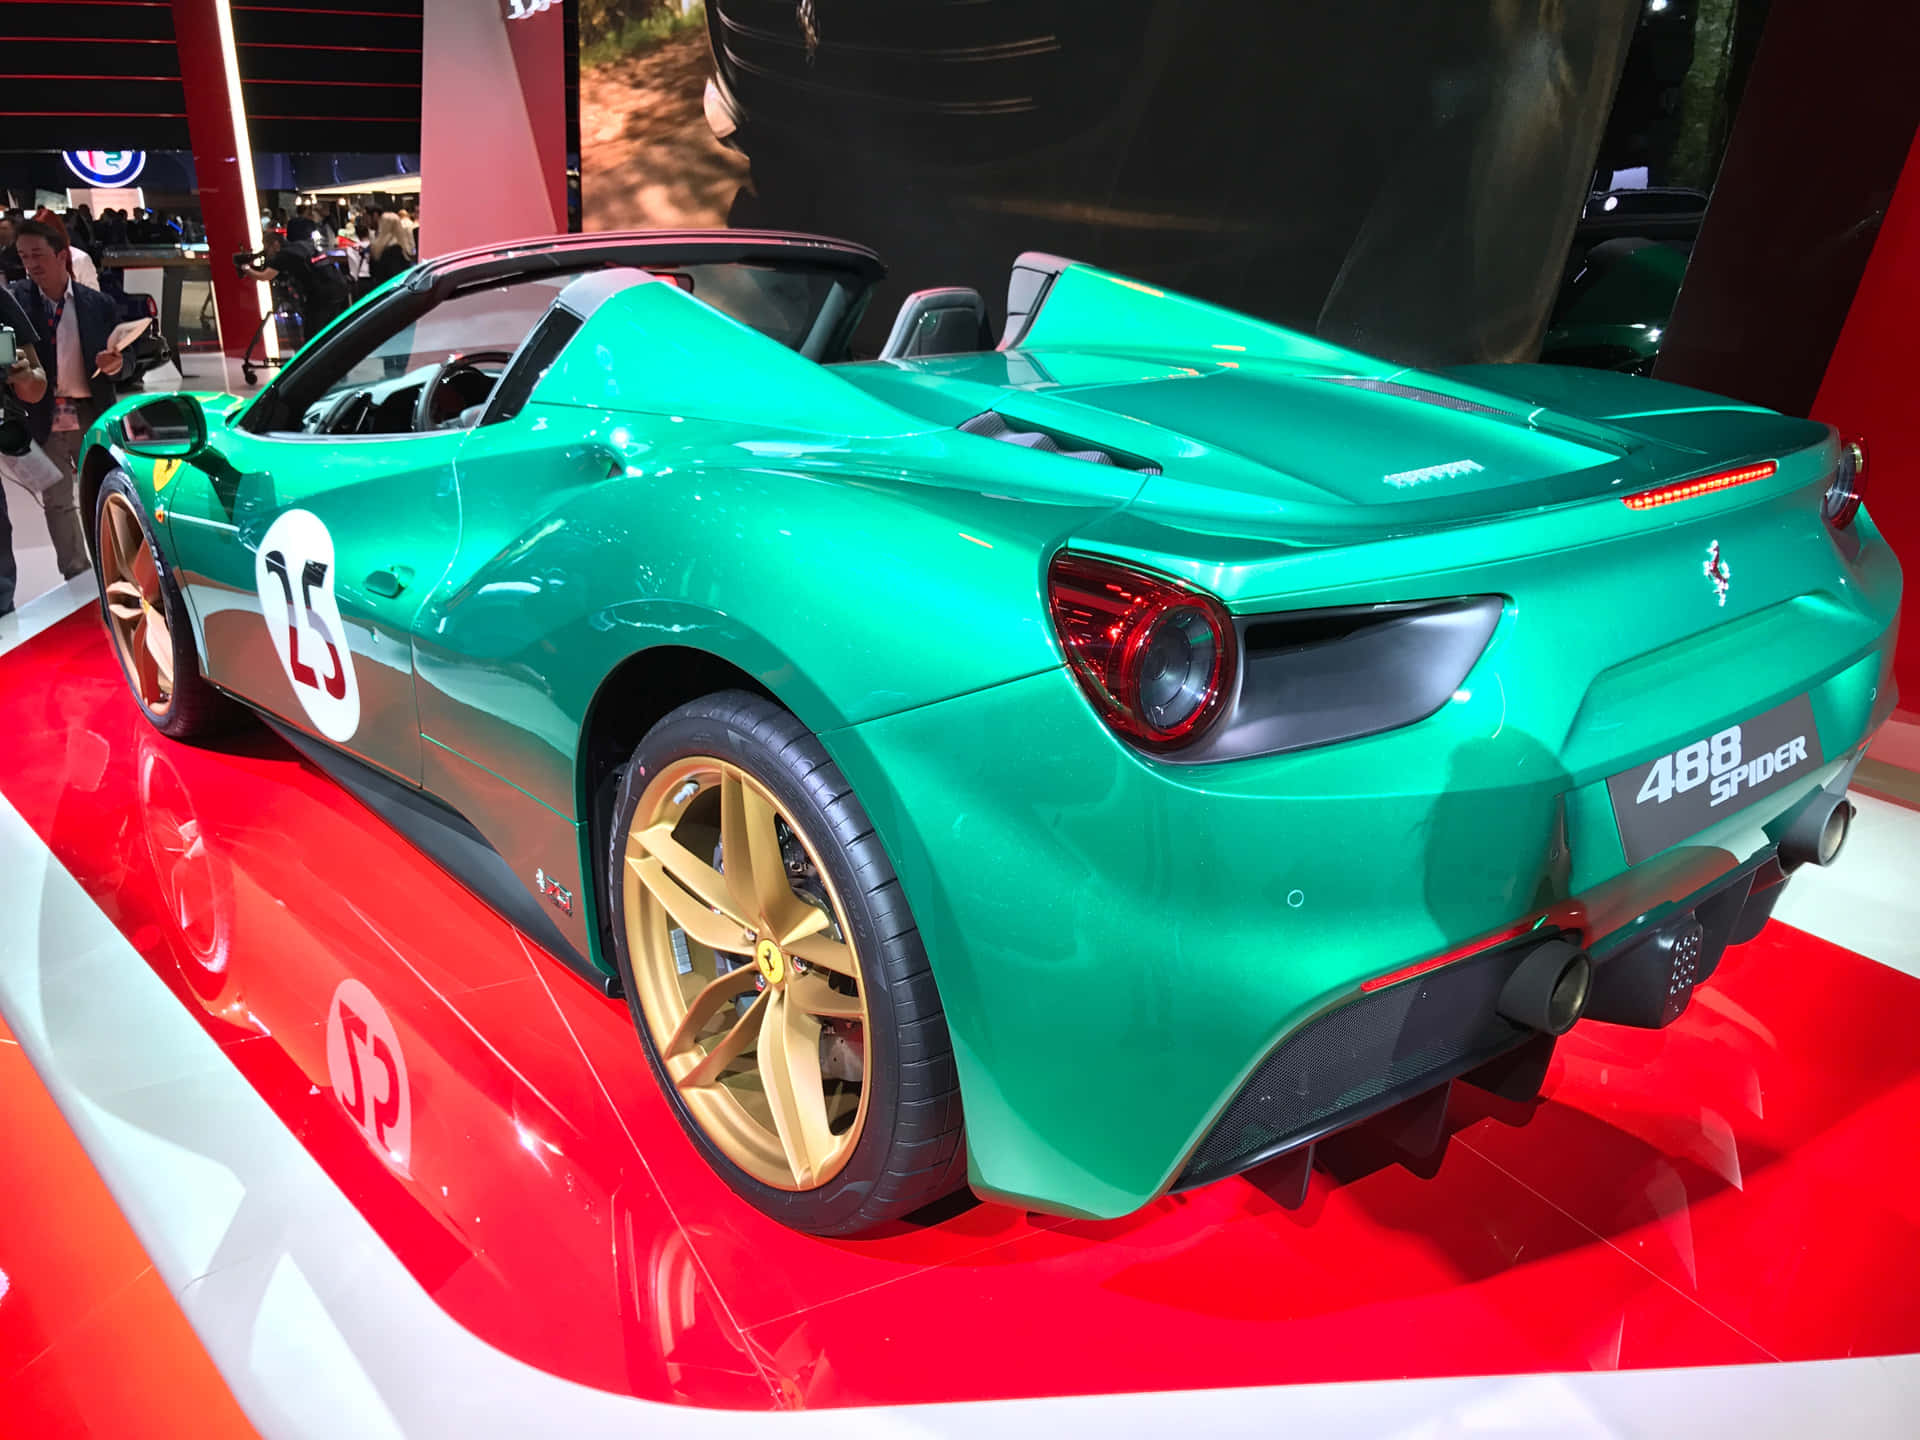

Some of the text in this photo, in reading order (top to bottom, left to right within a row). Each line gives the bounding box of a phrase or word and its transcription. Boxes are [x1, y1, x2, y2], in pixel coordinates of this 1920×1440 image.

[265, 550, 346, 700] 25
[1636, 725, 1742, 805] 488
[1710, 735, 1808, 807] SPIDER
